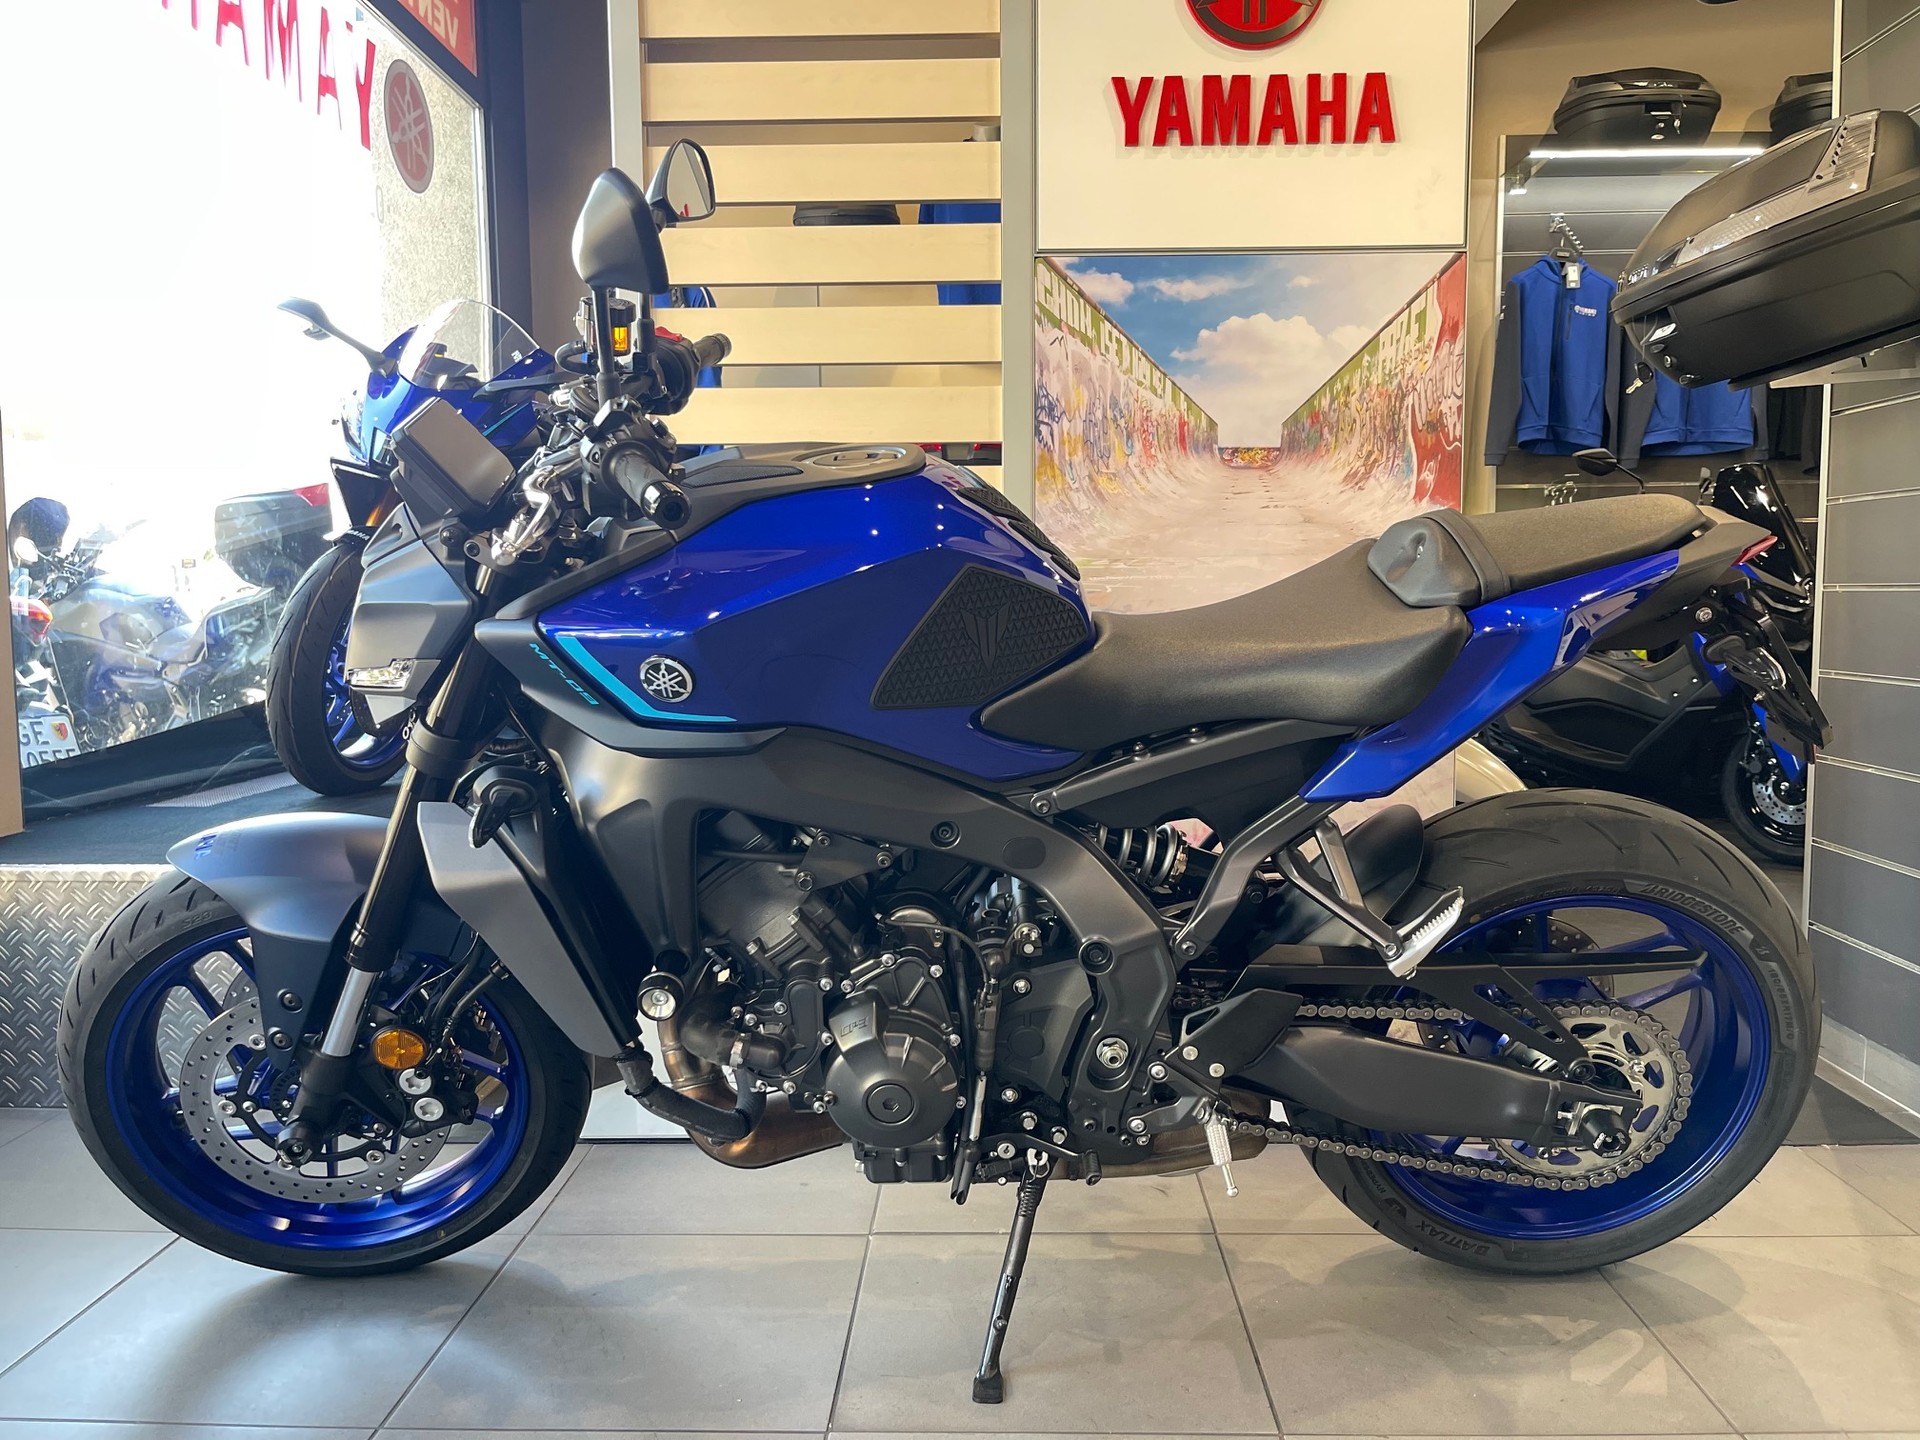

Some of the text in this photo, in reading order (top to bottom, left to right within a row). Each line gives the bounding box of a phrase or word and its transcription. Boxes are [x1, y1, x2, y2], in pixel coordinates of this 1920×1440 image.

[1110, 72, 1396, 148] YAMAHA
[529, 643, 599, 705] MT-09
[20, 721, 50, 746] GE
[1639, 883, 1745, 935] BRIDGESTONE
[1415, 1219, 1491, 1257] BATTLAX
